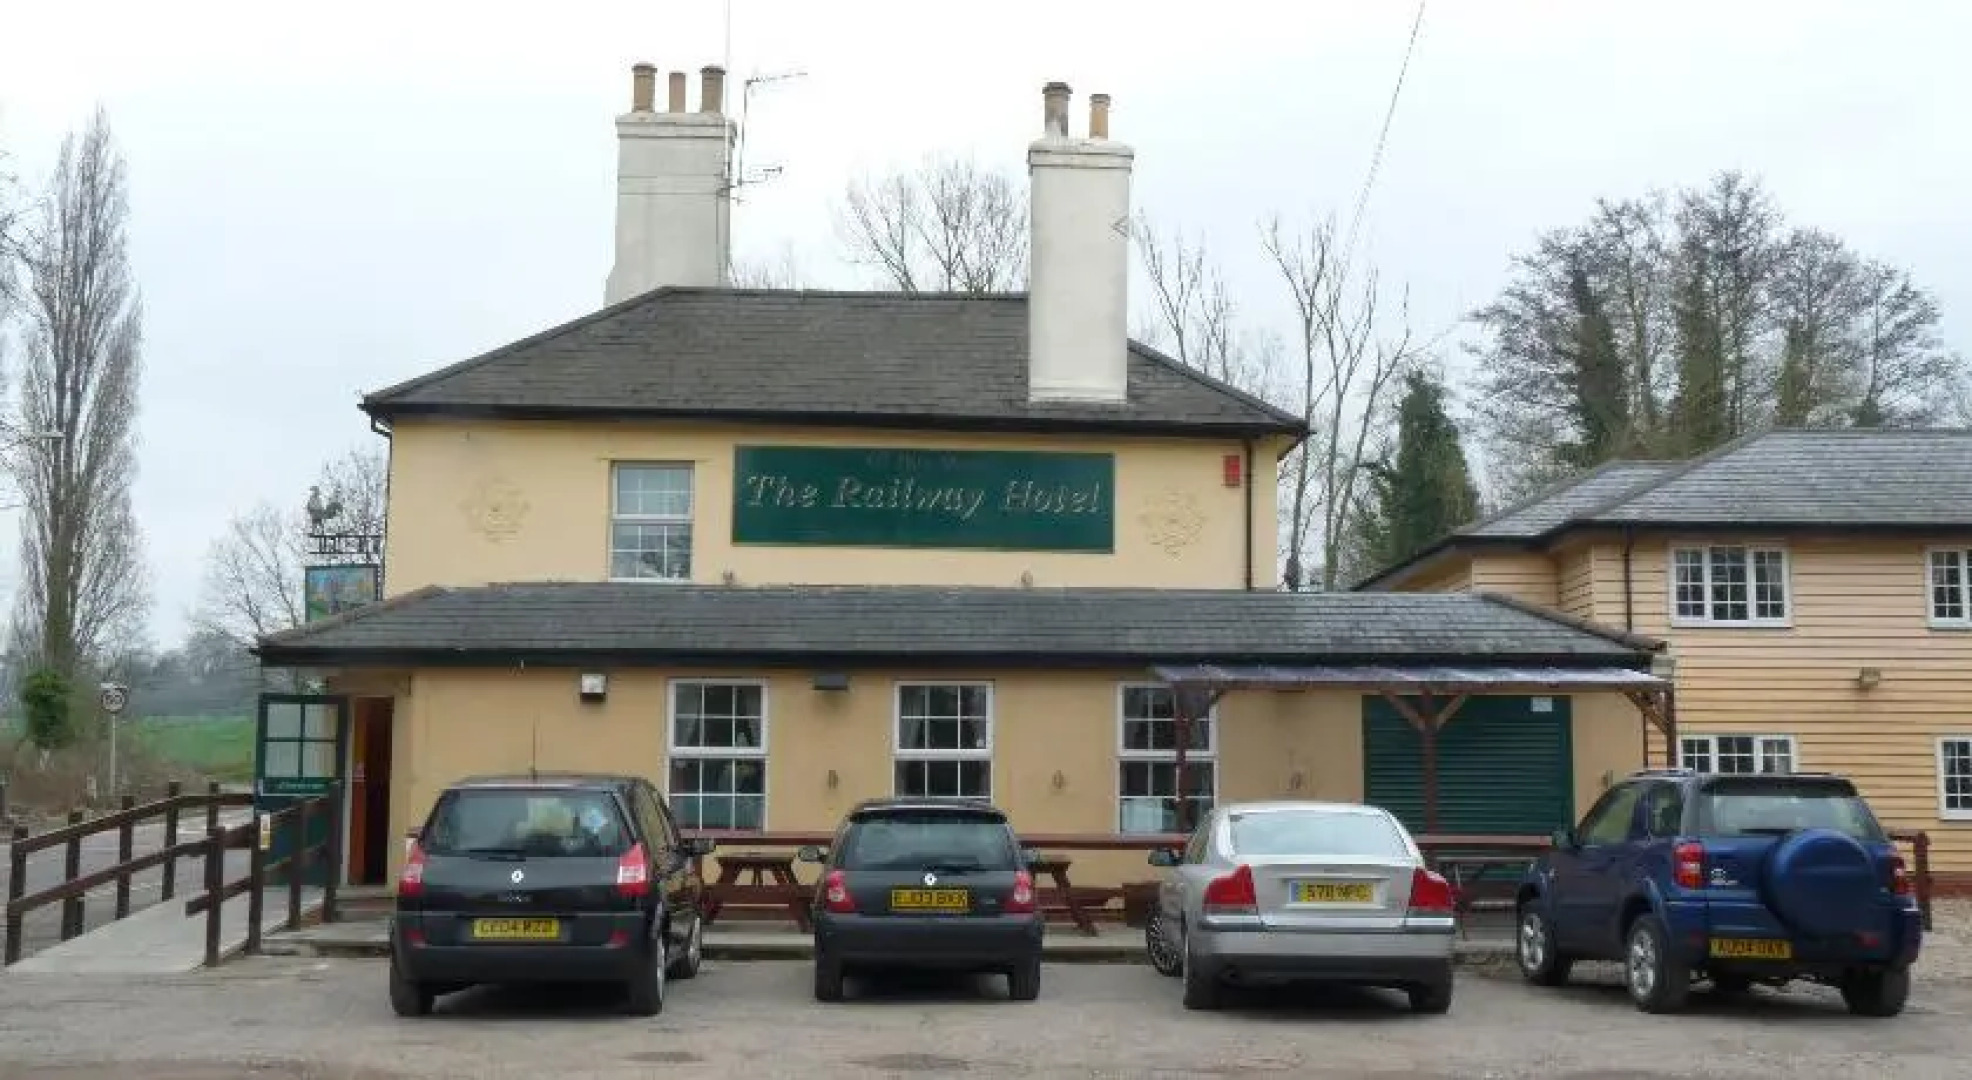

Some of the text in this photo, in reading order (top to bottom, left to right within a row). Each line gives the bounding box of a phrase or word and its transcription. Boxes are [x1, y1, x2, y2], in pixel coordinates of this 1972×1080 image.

[748, 475, 1100, 520] The Railway Hotel
